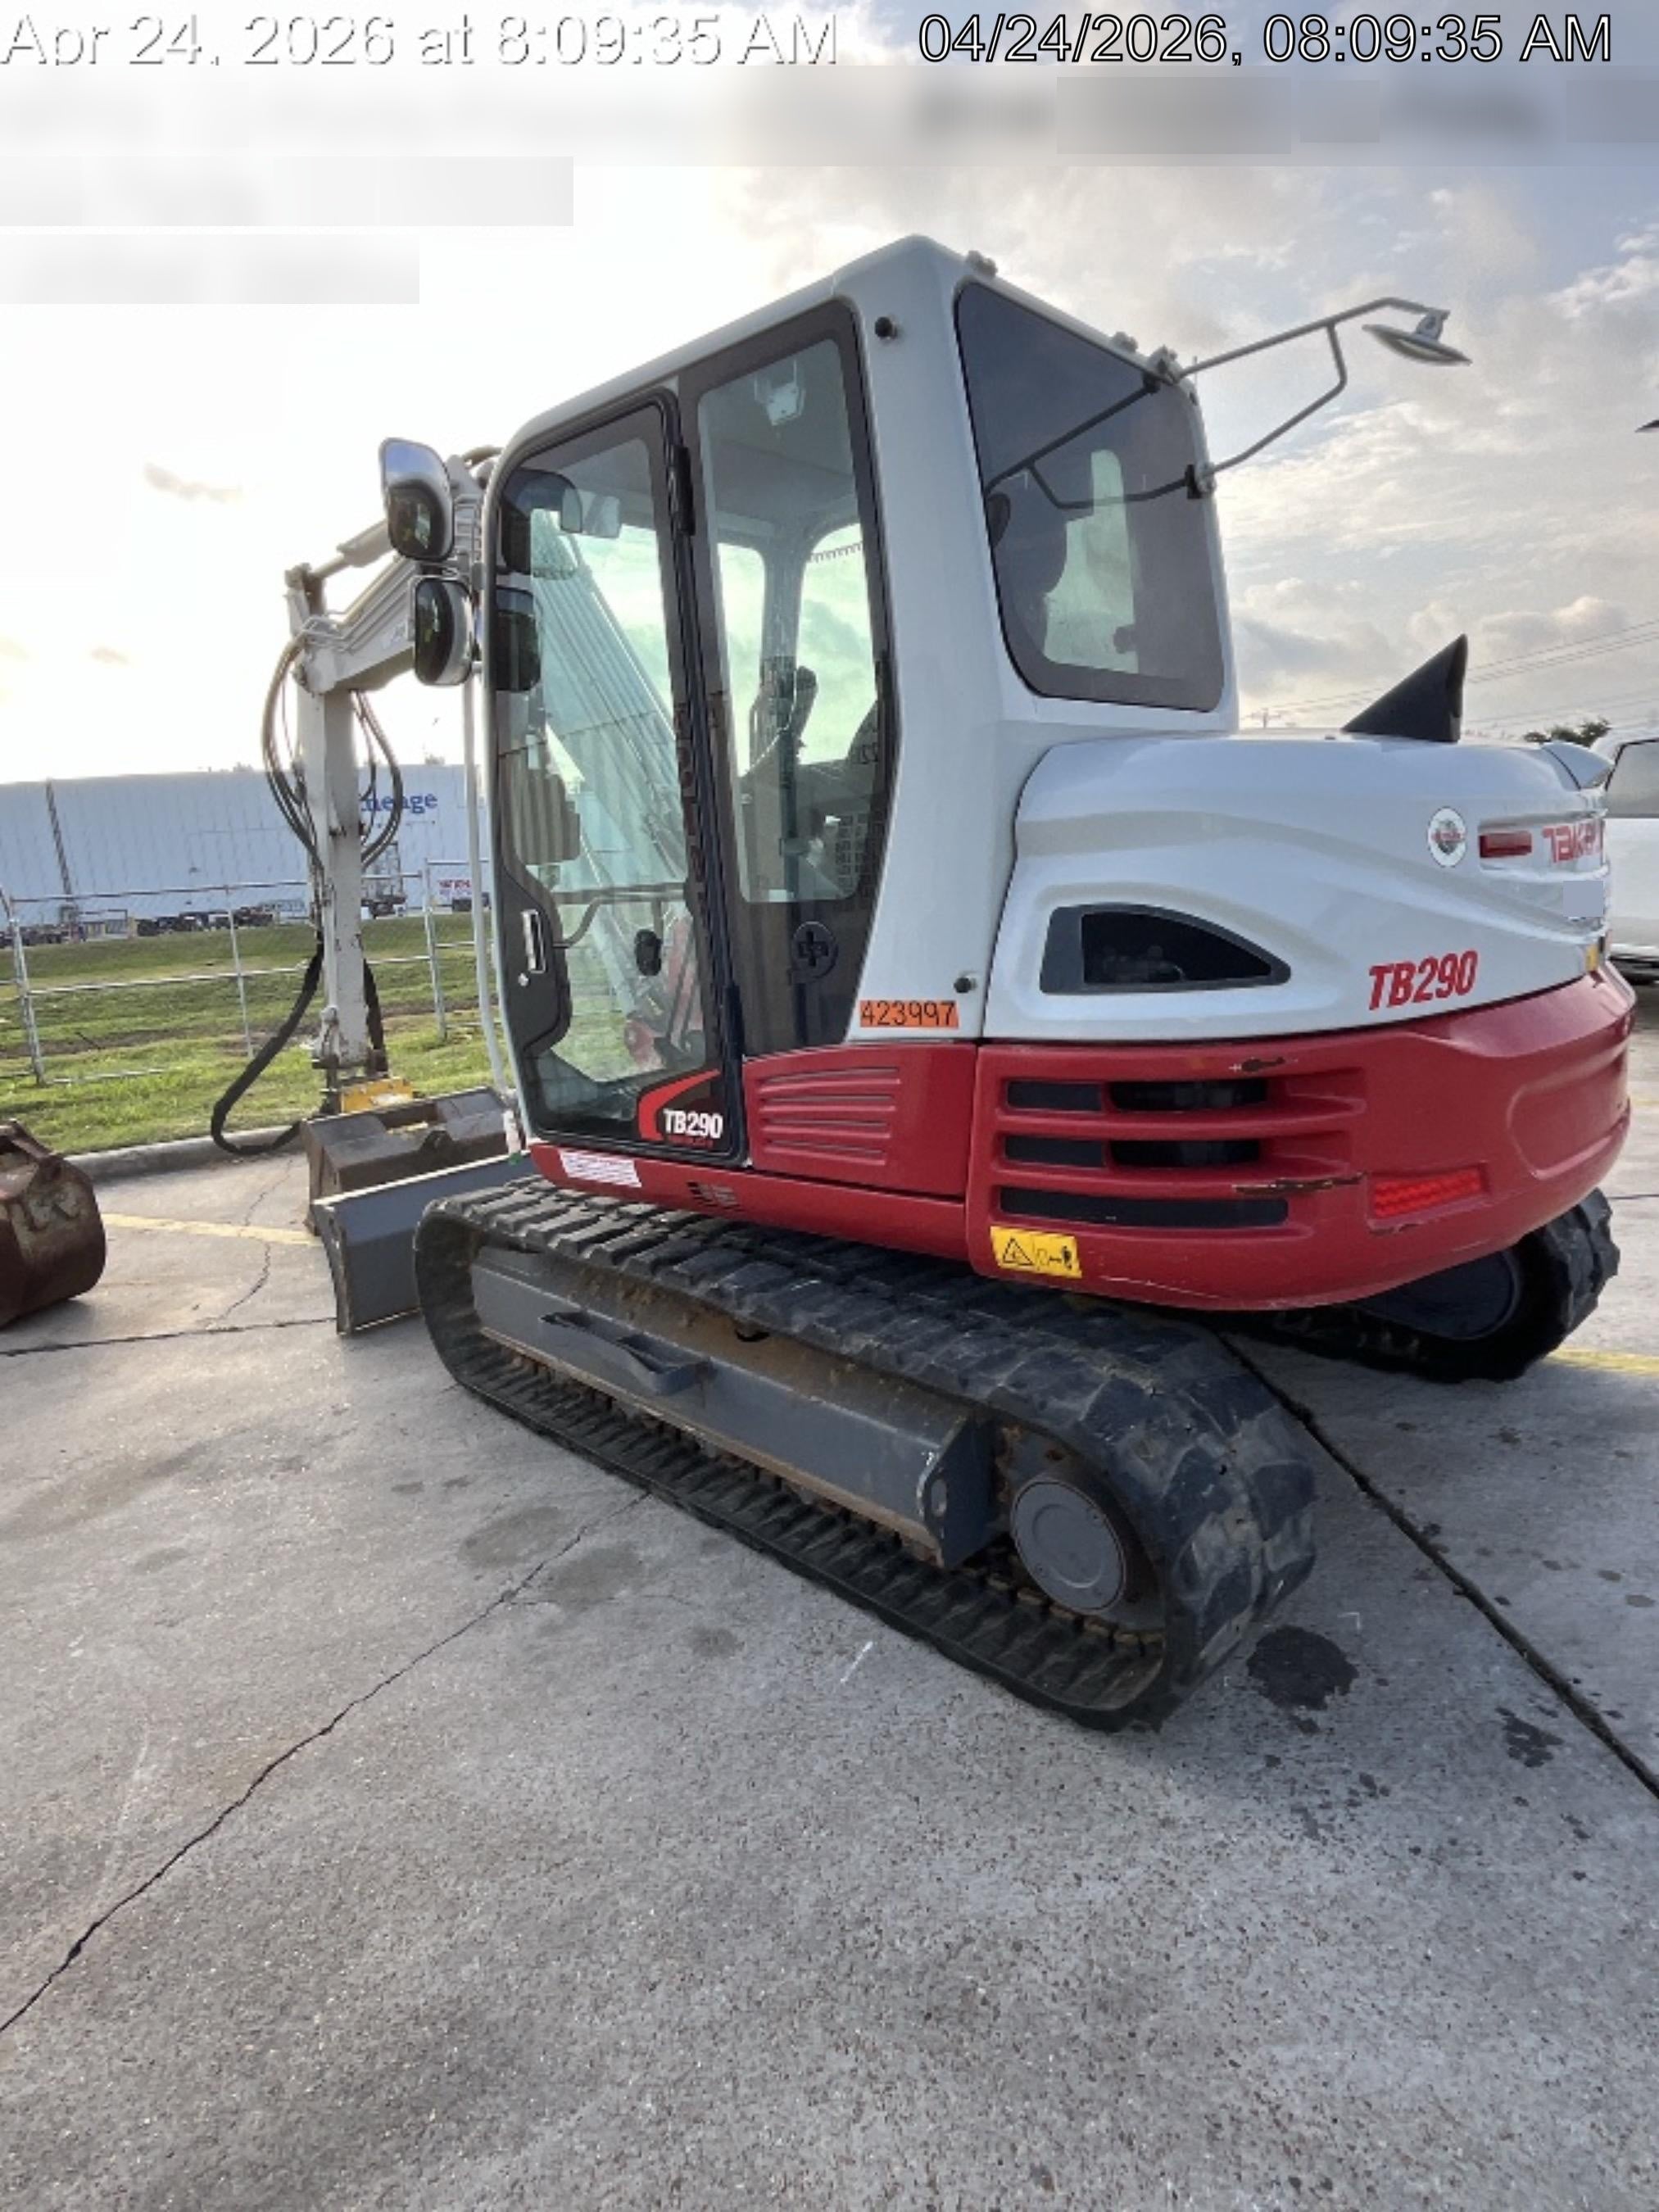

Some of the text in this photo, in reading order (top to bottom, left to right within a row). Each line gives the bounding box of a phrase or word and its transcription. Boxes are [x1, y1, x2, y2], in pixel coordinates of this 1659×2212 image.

[1368, 949, 1478, 1011] TB290
[861, 999, 956, 1026] 423997
[663, 1108, 723, 1139] TB290
